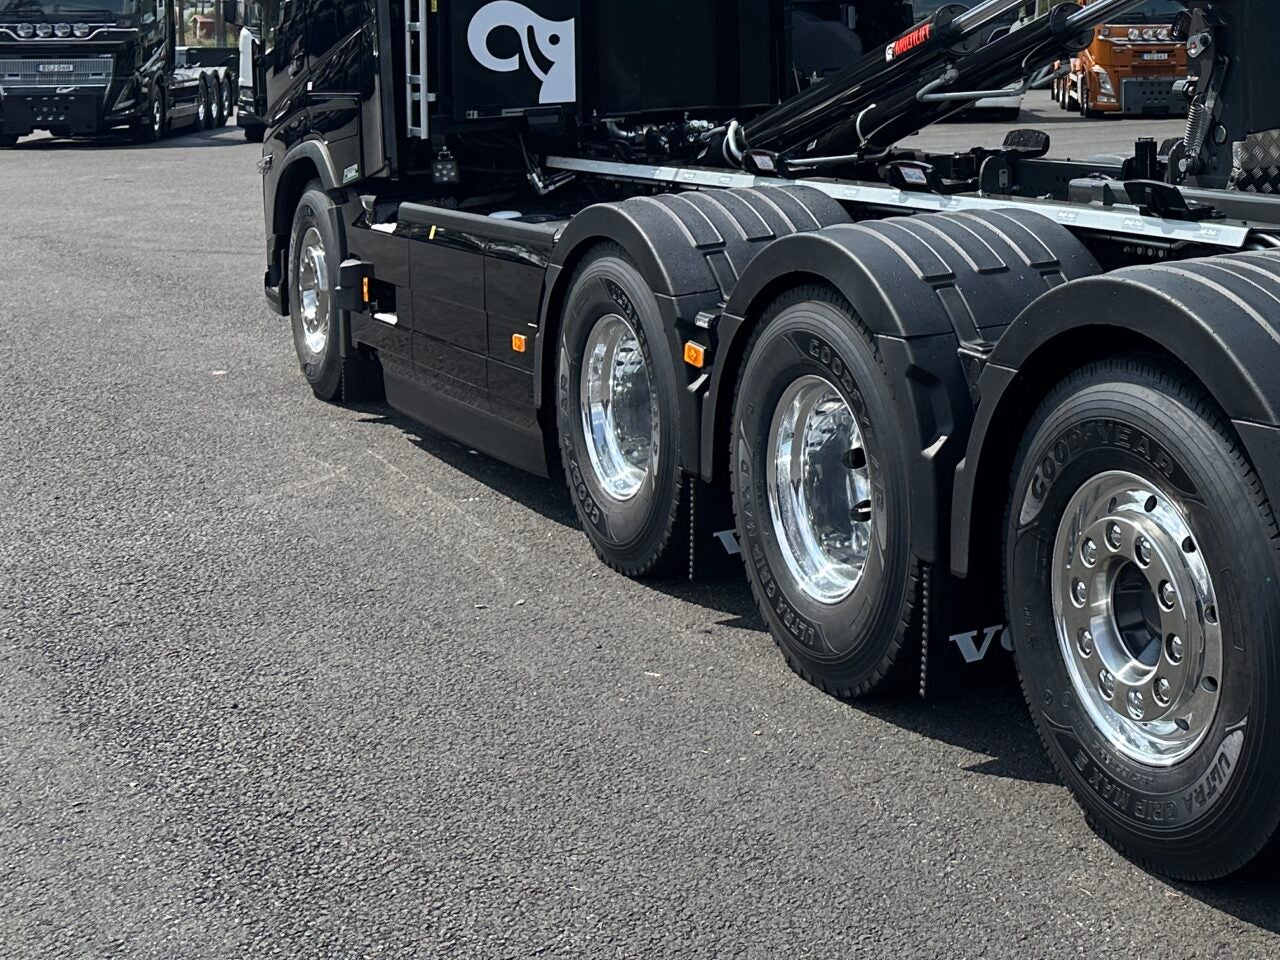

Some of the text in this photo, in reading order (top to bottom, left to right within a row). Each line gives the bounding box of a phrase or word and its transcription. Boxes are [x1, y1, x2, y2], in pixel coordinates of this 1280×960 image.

[895, 23, 930, 56] MULTILIFT
[777, 606, 816, 648] ULTRA
[1088, 766, 1131, 812] MAX
[1184, 752, 1232, 816] ULTRA
[1134, 798, 1177, 822] GRIP
